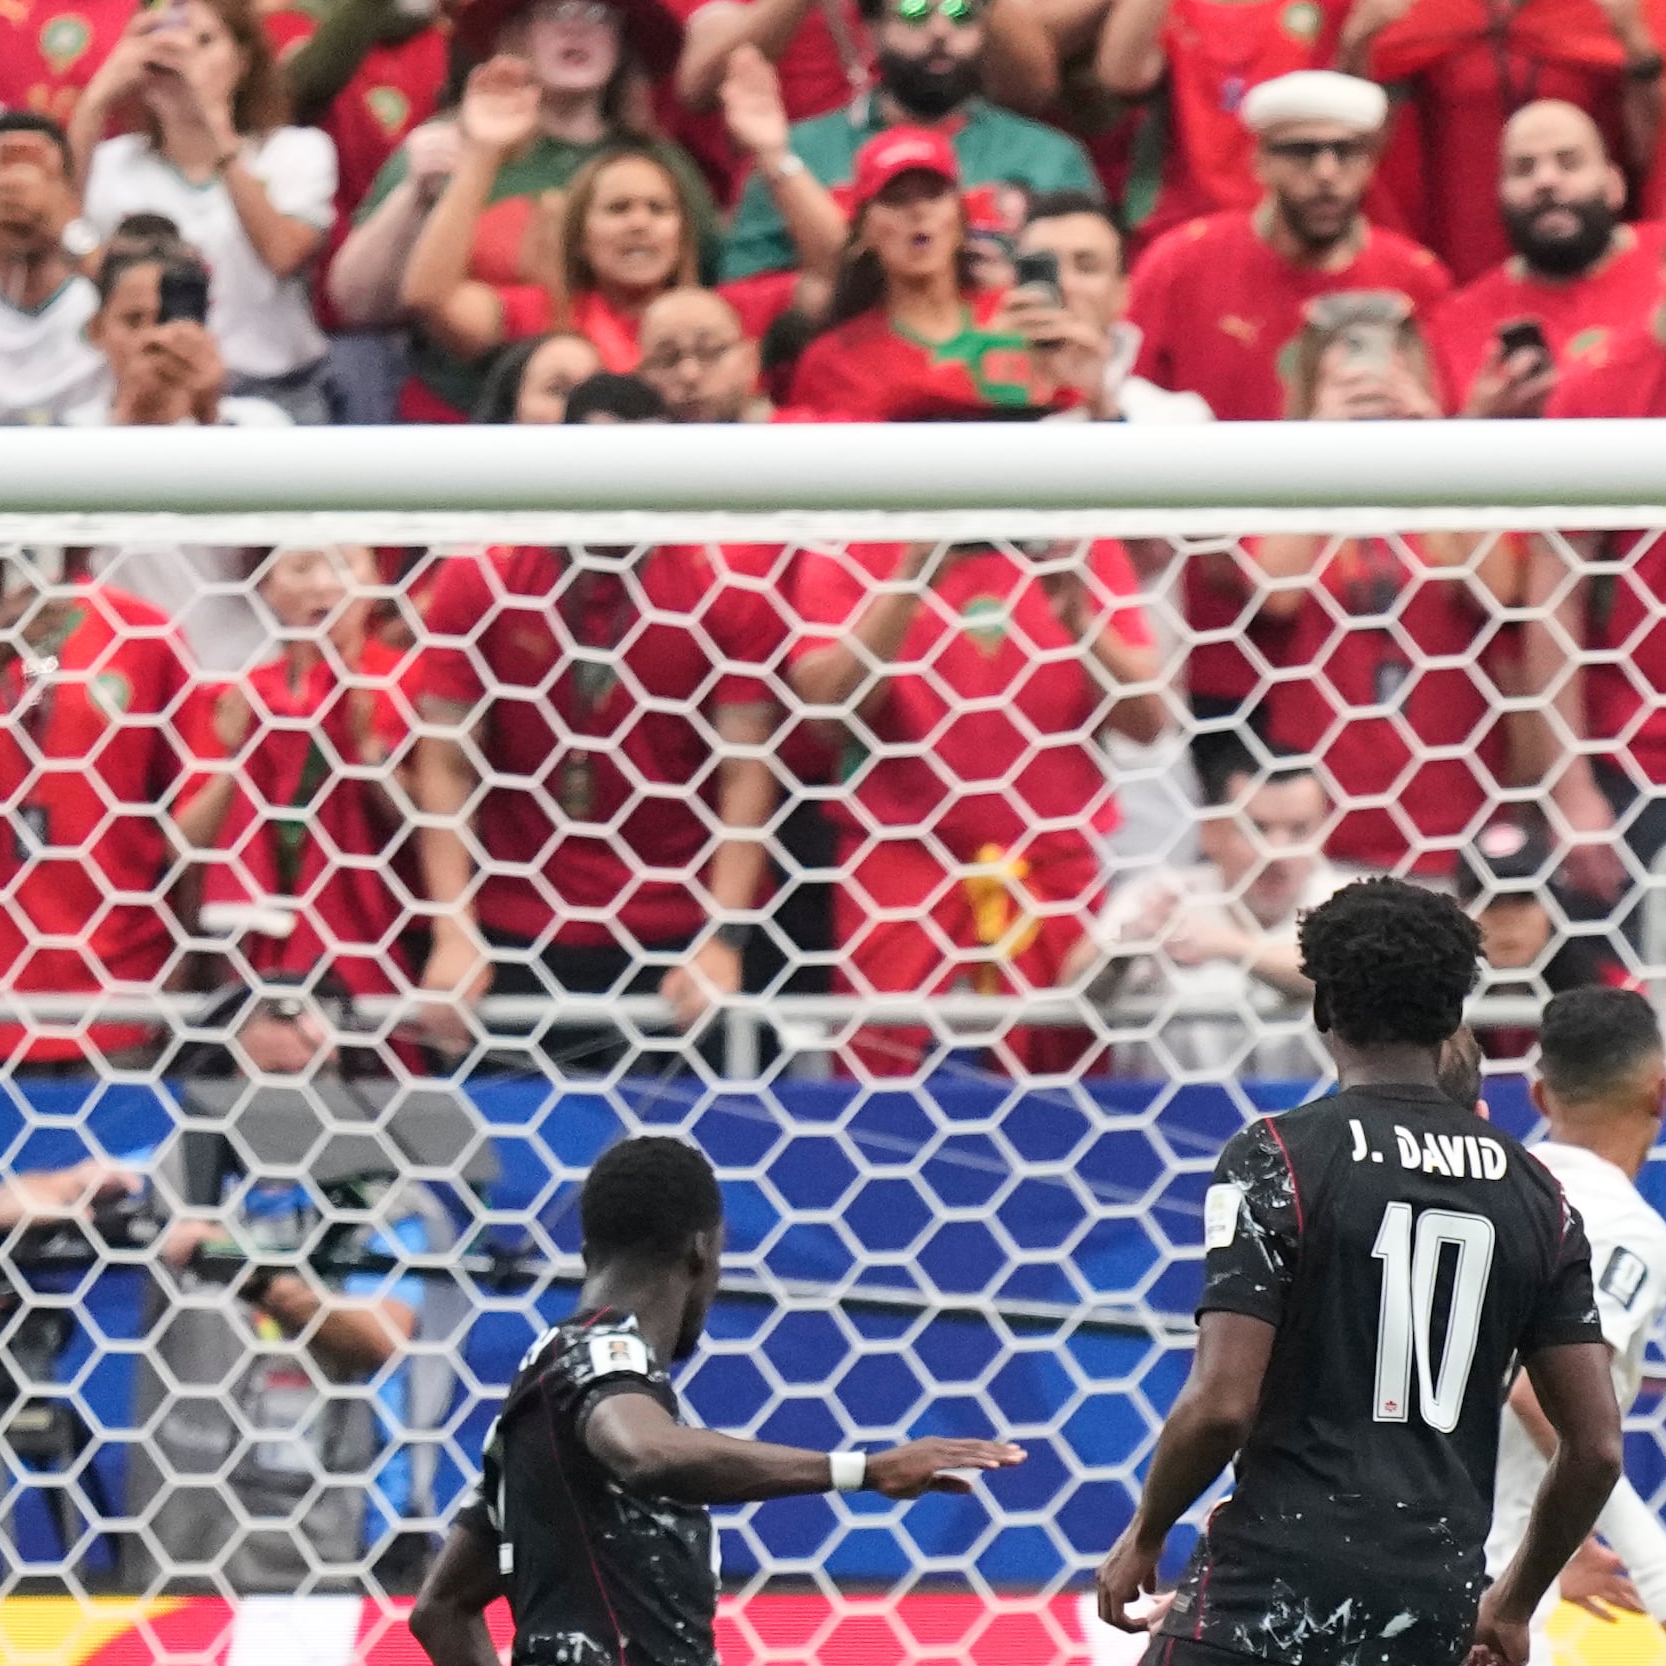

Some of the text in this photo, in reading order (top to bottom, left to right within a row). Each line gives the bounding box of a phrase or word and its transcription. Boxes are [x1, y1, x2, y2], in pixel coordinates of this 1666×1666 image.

[1348, 1119, 1507, 1181] J. DAVID
[1371, 1201, 1496, 1434] 10
